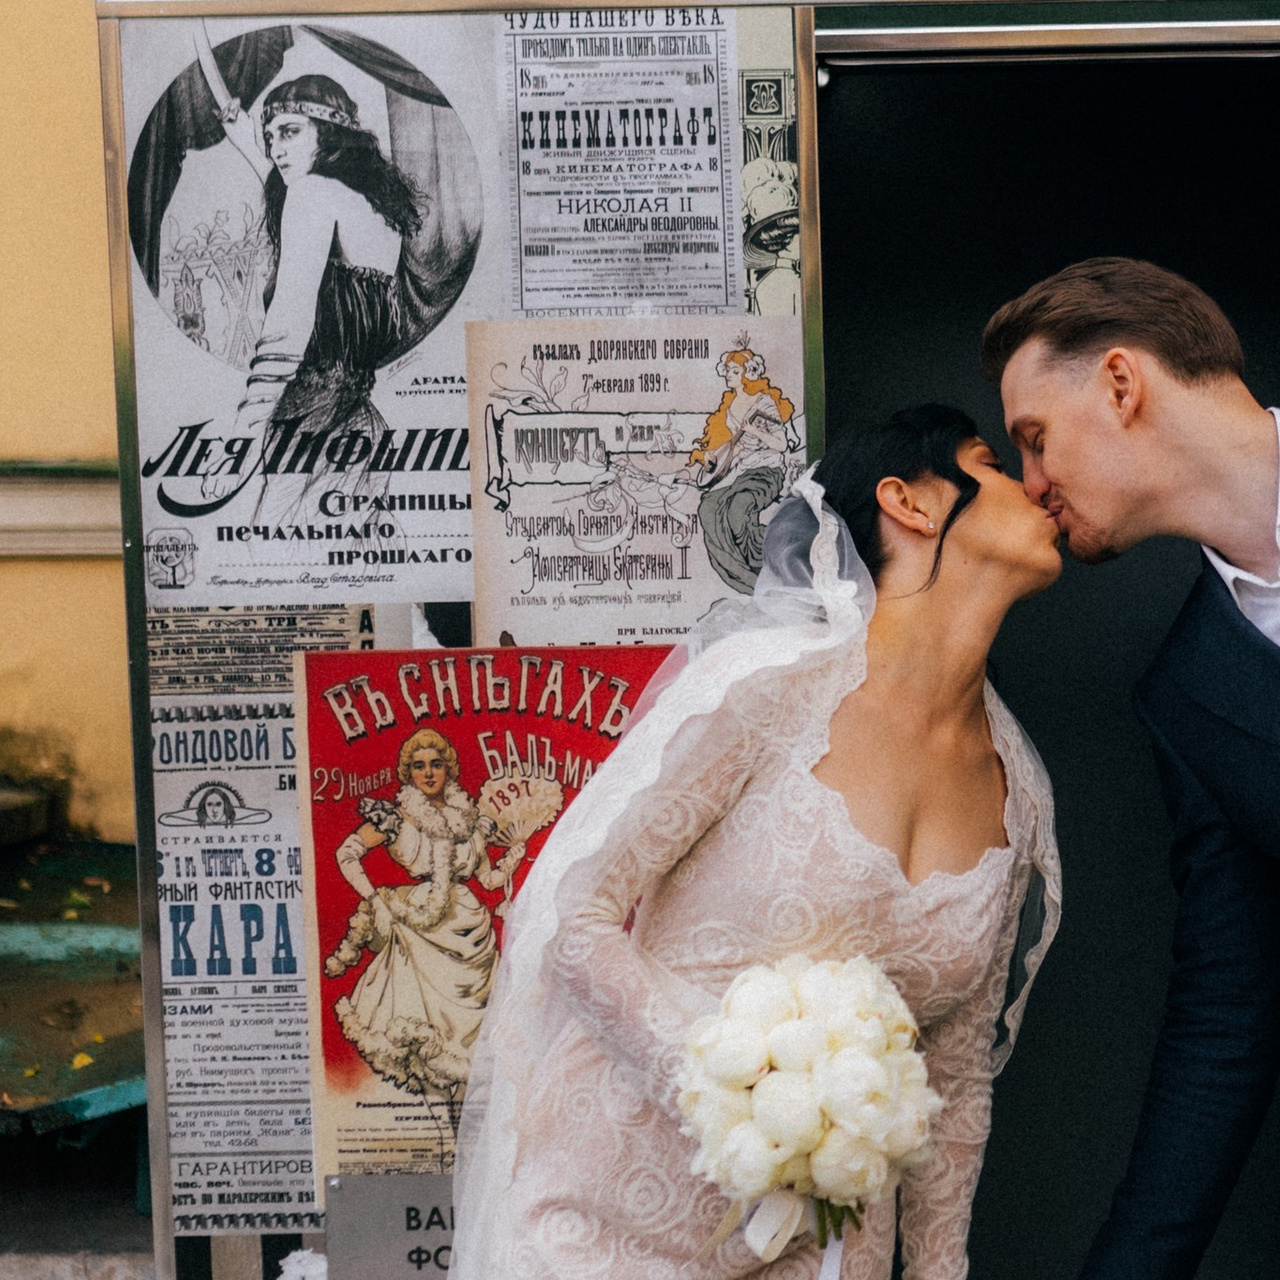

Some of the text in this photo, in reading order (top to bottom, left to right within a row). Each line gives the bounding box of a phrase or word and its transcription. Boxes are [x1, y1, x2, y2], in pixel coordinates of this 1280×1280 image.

[612, 36, 624, 57] НА
[520, 68, 531, 89] 18
[703, 64, 715, 84] 18
[521, 107, 717, 150] КИНЕМАТОГРАФЪ
[522, 157, 718, 176] 18 КИНЕМАТОГРАФА 18
[557, 197, 692, 215] НИКОЛАЯ II
[583, 217, 648, 233] АЛЕКСАНДРЫ
[411, 375, 467, 386] ДРАМА
[638, 373, 661, 393] 1899
[141, 418, 256, 478] ЛЕЯ
[319, 489, 472, 517] СТРАНИЦЫ
[217, 522, 395, 542] ПЕЧАЛЬНАГО
[328, 548, 472, 565] ПРОШЛАГО
[677, 546, 692, 580] II
[323, 674, 398, 744] ВЪ
[151, 723, 269, 764] ОНДОВОЙ
[313, 767, 344, 802] 29
[488, 779, 532, 815] 1897
[161, 834, 282, 845] СТРАИВАЕТСЯ
[169, 903, 297, 976] КАРА
[178, 1160, 313, 1176] ГАРАНТИРОВ
